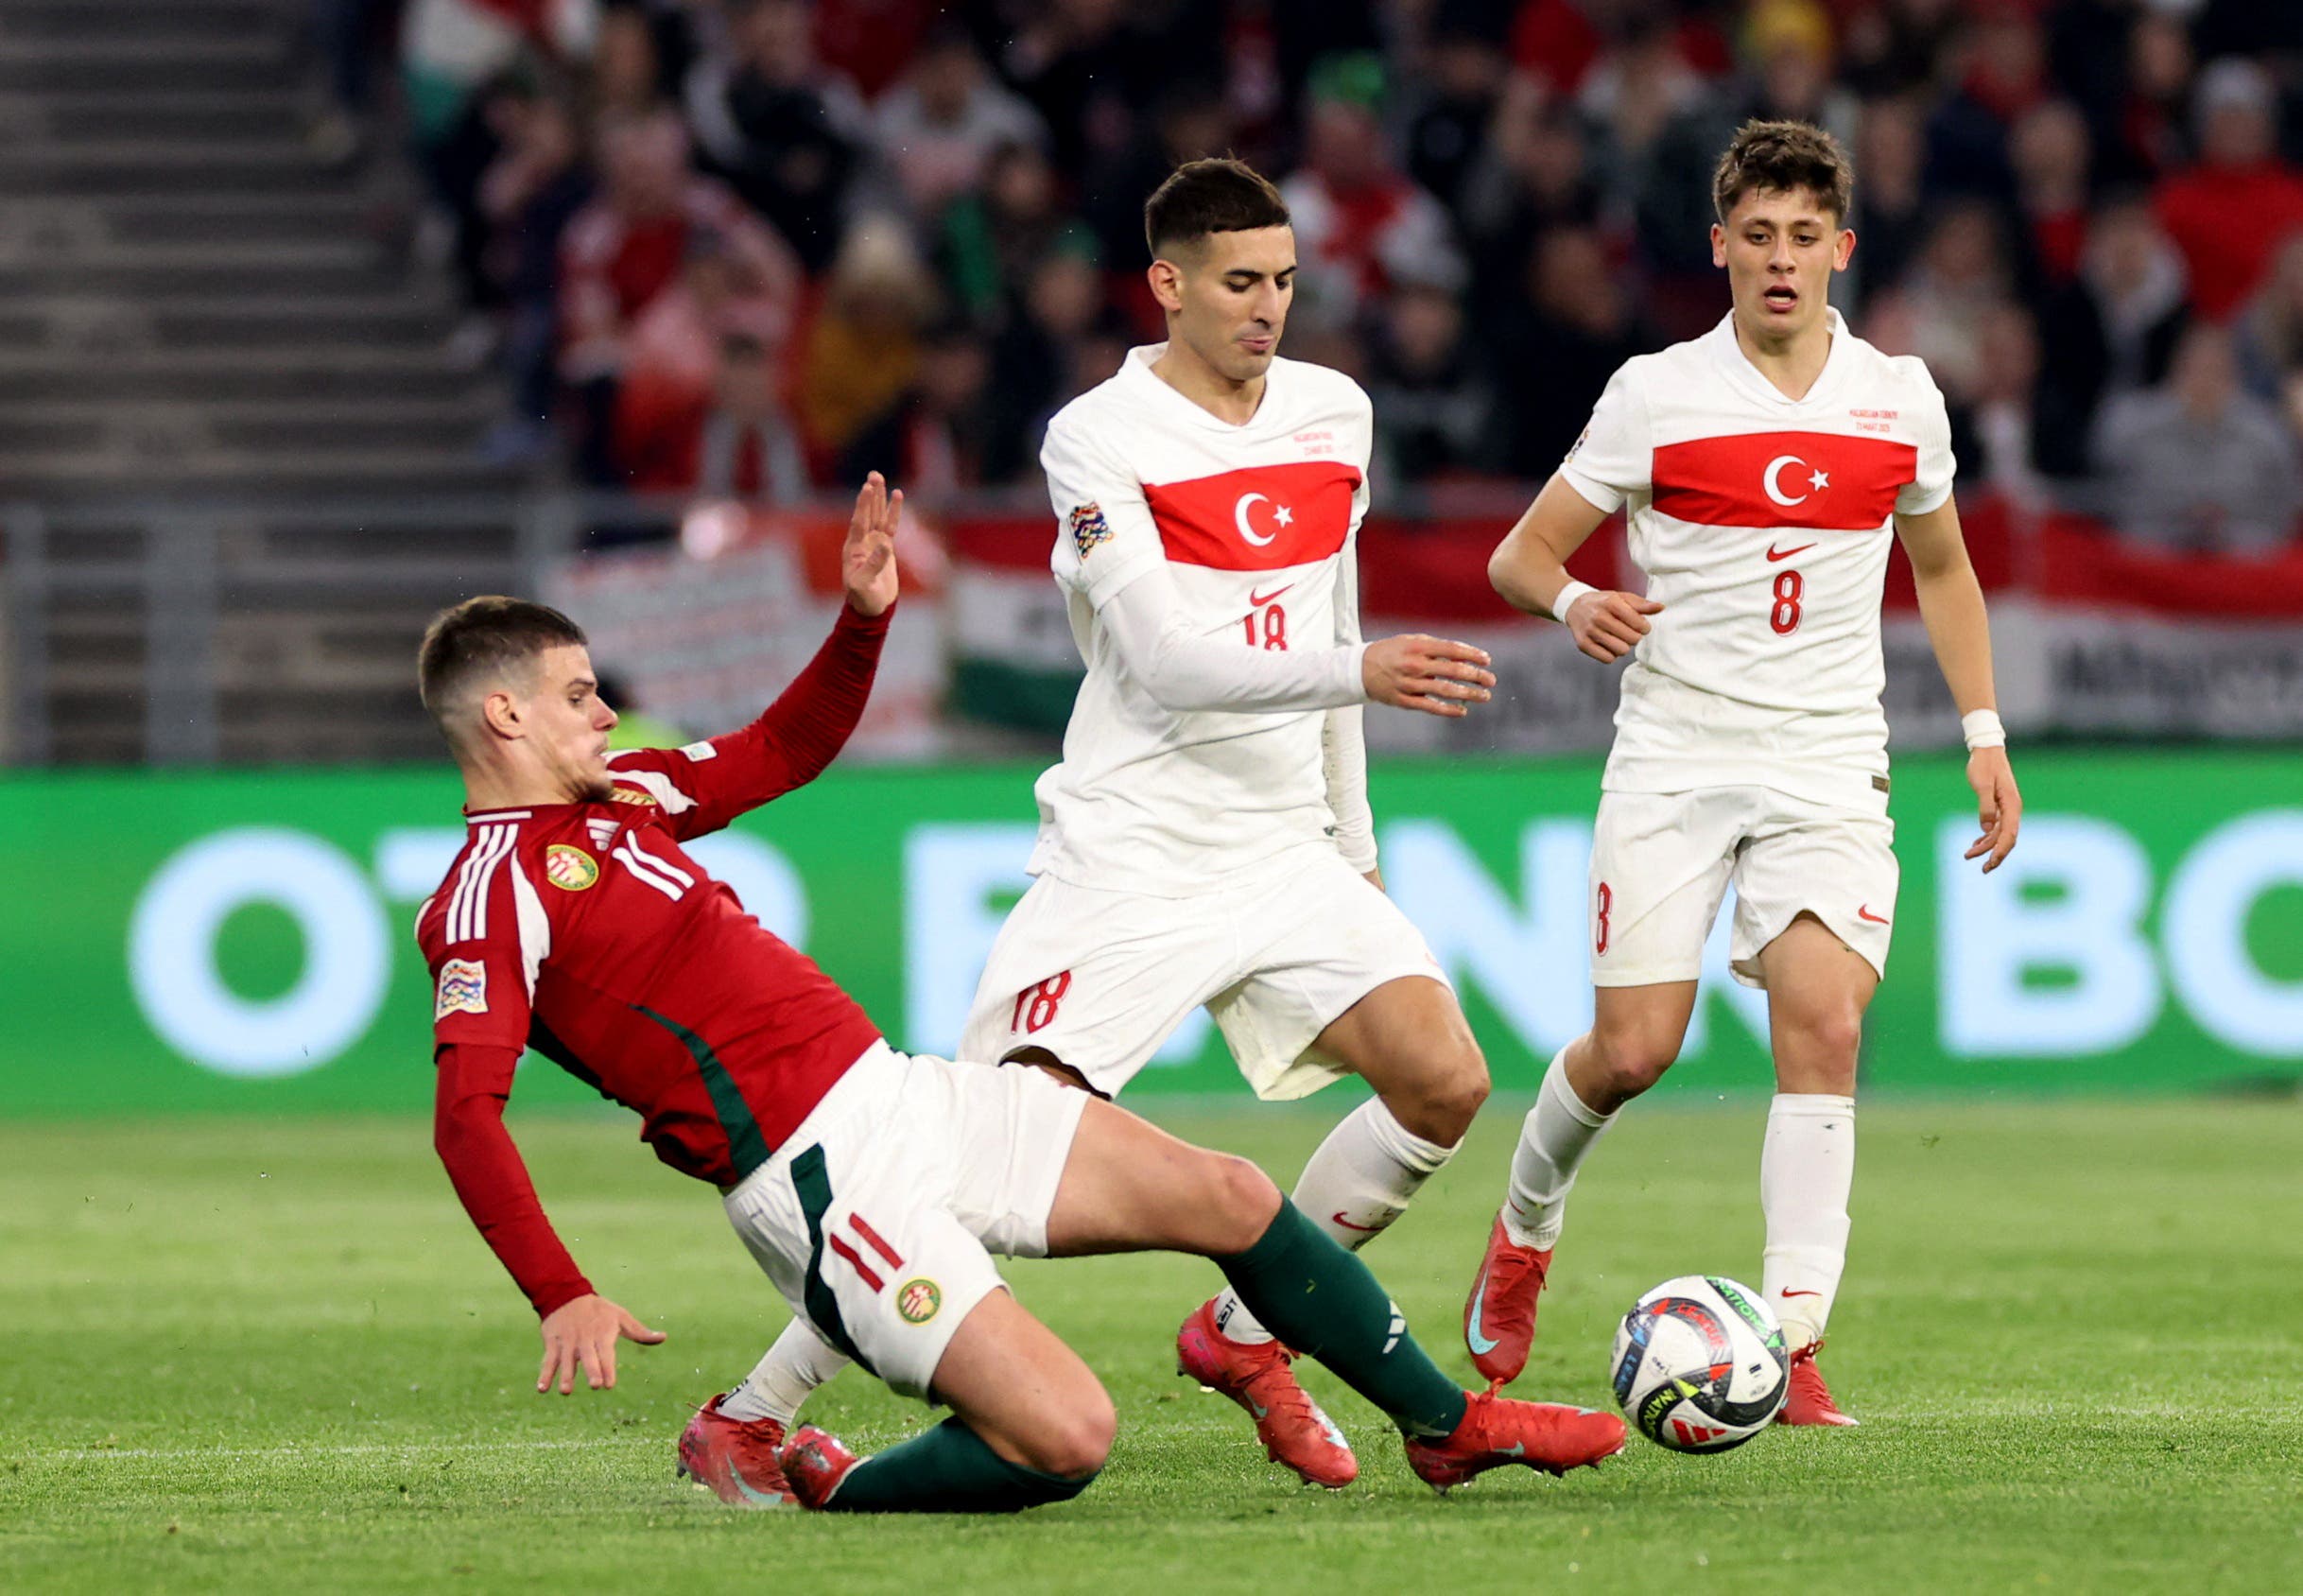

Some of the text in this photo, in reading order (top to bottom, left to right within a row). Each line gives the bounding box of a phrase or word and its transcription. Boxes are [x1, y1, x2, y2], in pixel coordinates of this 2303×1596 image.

[1770, 569, 1805, 637] 8
[612, 828, 696, 903] 11
[1596, 881, 1613, 957] 8
[1010, 969, 1072, 1035] 18
[829, 1211, 906, 1294] 11
